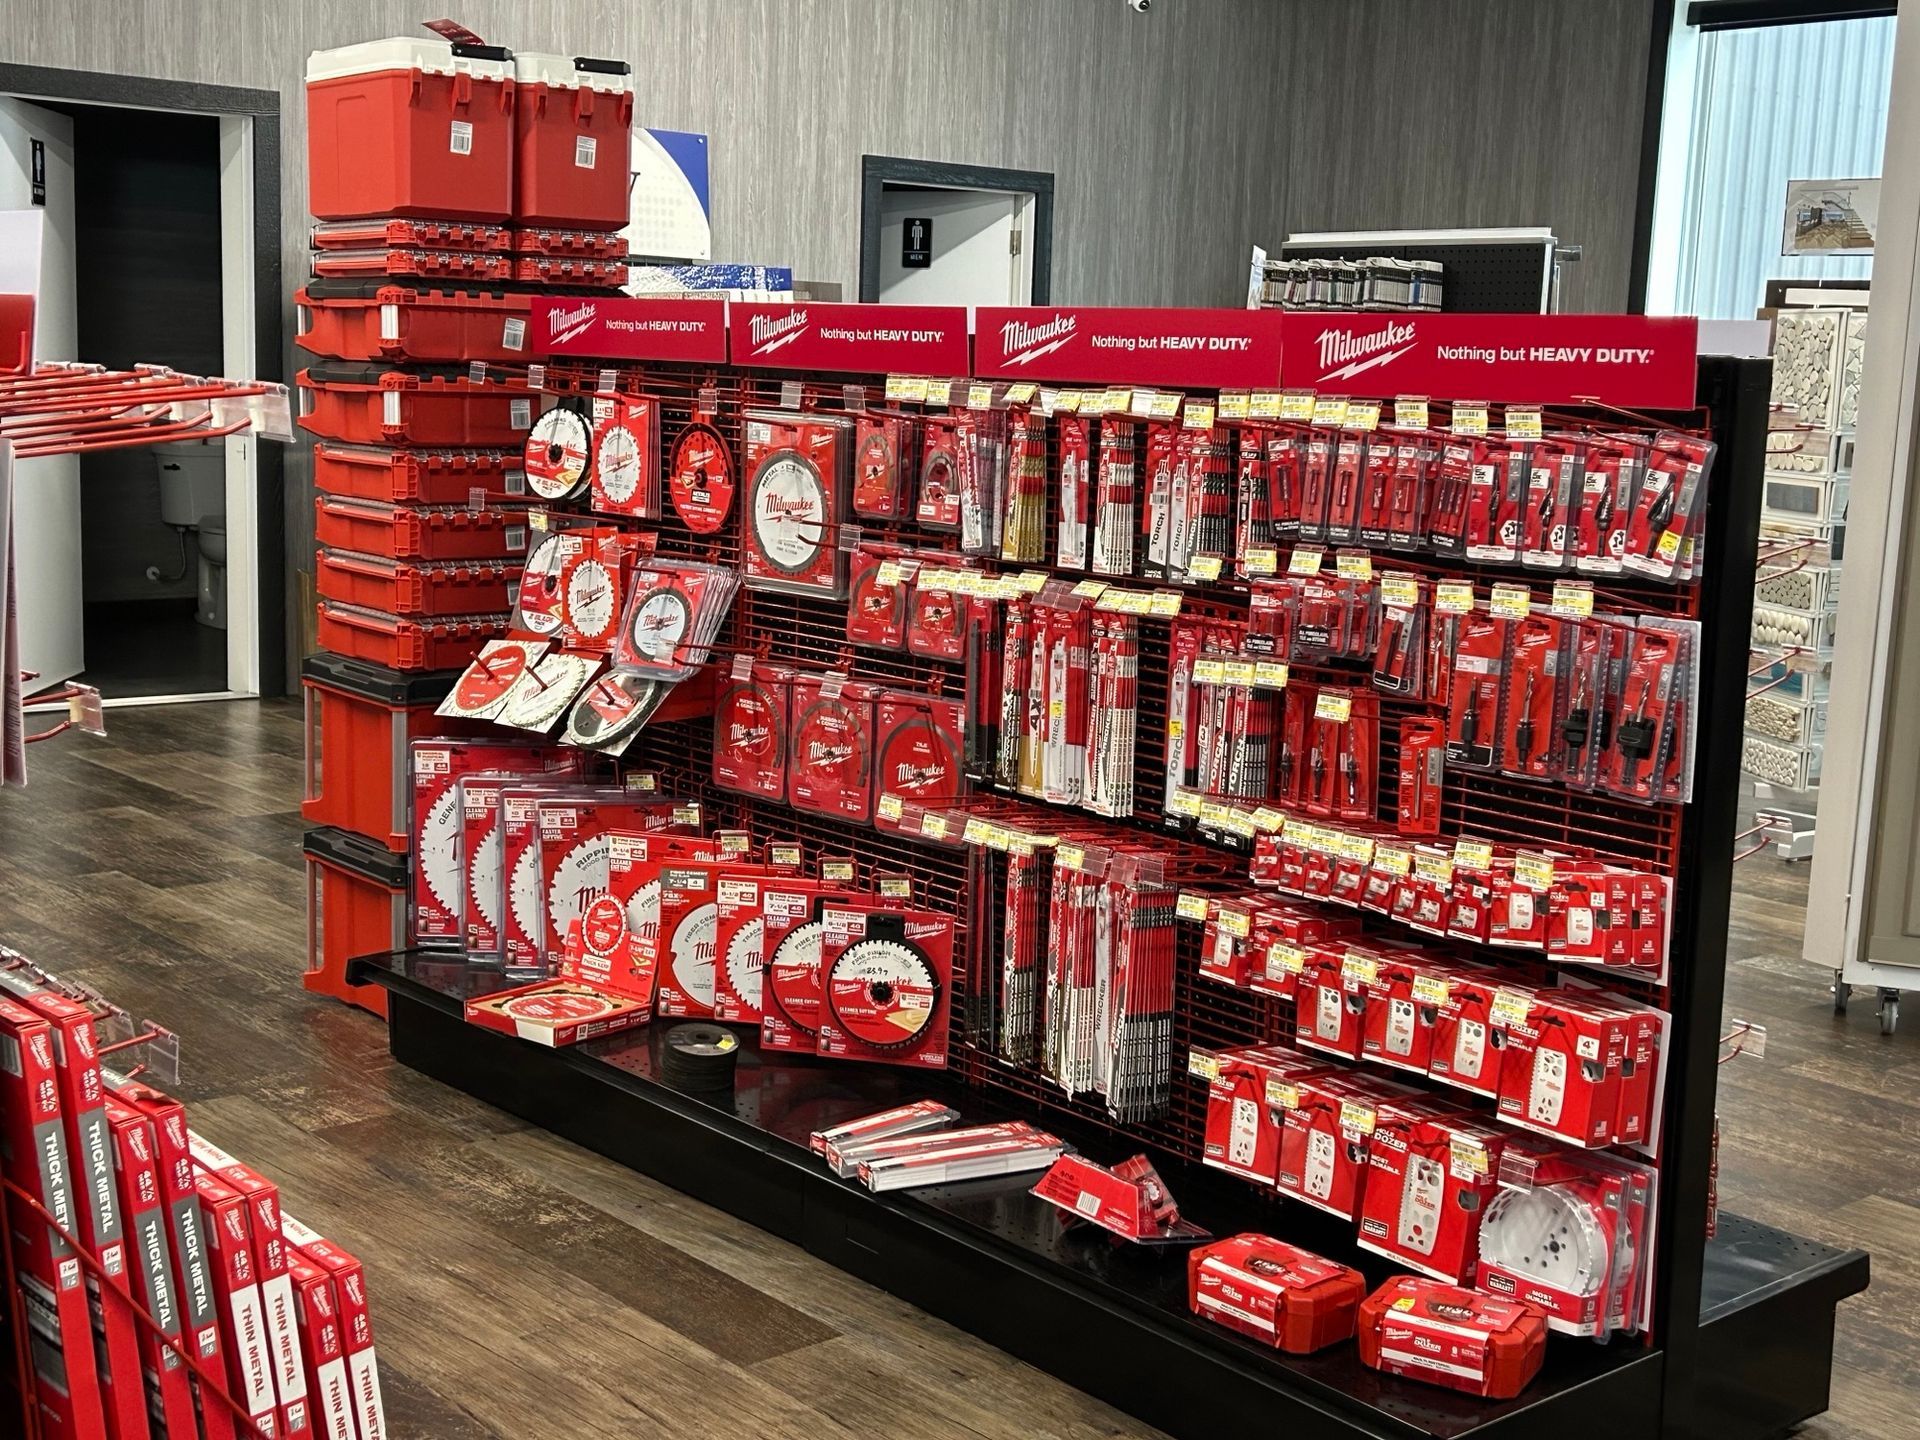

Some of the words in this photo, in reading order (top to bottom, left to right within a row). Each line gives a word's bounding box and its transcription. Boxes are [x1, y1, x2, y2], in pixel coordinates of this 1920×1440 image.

[547, 302, 597, 336] Milwaukee
[606, 319, 634, 332] Nothing
[635, 320, 648, 330] but
[649, 320, 677, 331] HEAVY
[748, 308, 808, 346] Milwaukee
[821, 328, 855, 342] Nothing
[856, 328, 872, 340] but
[873, 330, 910, 341] HEAVY
[999, 313, 1077, 356] Milwaukee
[1092, 335, 1136, 351] Nothing
[1138, 336, 1157, 349] but
[1160, 336, 1206, 350] HEAVY
[1314, 320, 1416, 370] Milwaukee
[1437, 345, 1496, 364] Nothing
[1500, 347, 1526, 361] but
[1529, 347, 1592, 363] HEAVY
[761, 468, 777, 488] METAL
[765, 492, 815, 514] Milwaukee
[1151, 512, 1166, 546] TORCH
[1173, 519, 1184, 552] TORCH
[1168, 738, 1183, 779] TORC
[1230, 735, 1244, 792] TORCH
[795, 936, 810, 950] FINE
[904, 922, 947, 935] Milwaukee
[1095, 980, 1106, 1030] WRECKER
[44, 1131, 63, 1188] THICK
[89, 1120, 106, 1176] THICK
[1374, 1134, 1408, 1149] DOZER
[96, 1177, 114, 1233] METAL
[145, 1221, 163, 1274] THICK
[154, 1275, 171, 1329] METAL
[181, 1208, 199, 1261] THICK
[190, 1261, 208, 1316] METAL
[274, 1292, 287, 1331] THIN
[1532, 1290, 1552, 1300] MOST
[242, 1304, 256, 1343] THIN
[249, 1345, 264, 1397] METAL
[280, 1334, 295, 1386] METAL
[329, 1376, 343, 1414] THIN
[360, 1364, 374, 1402] THIN
